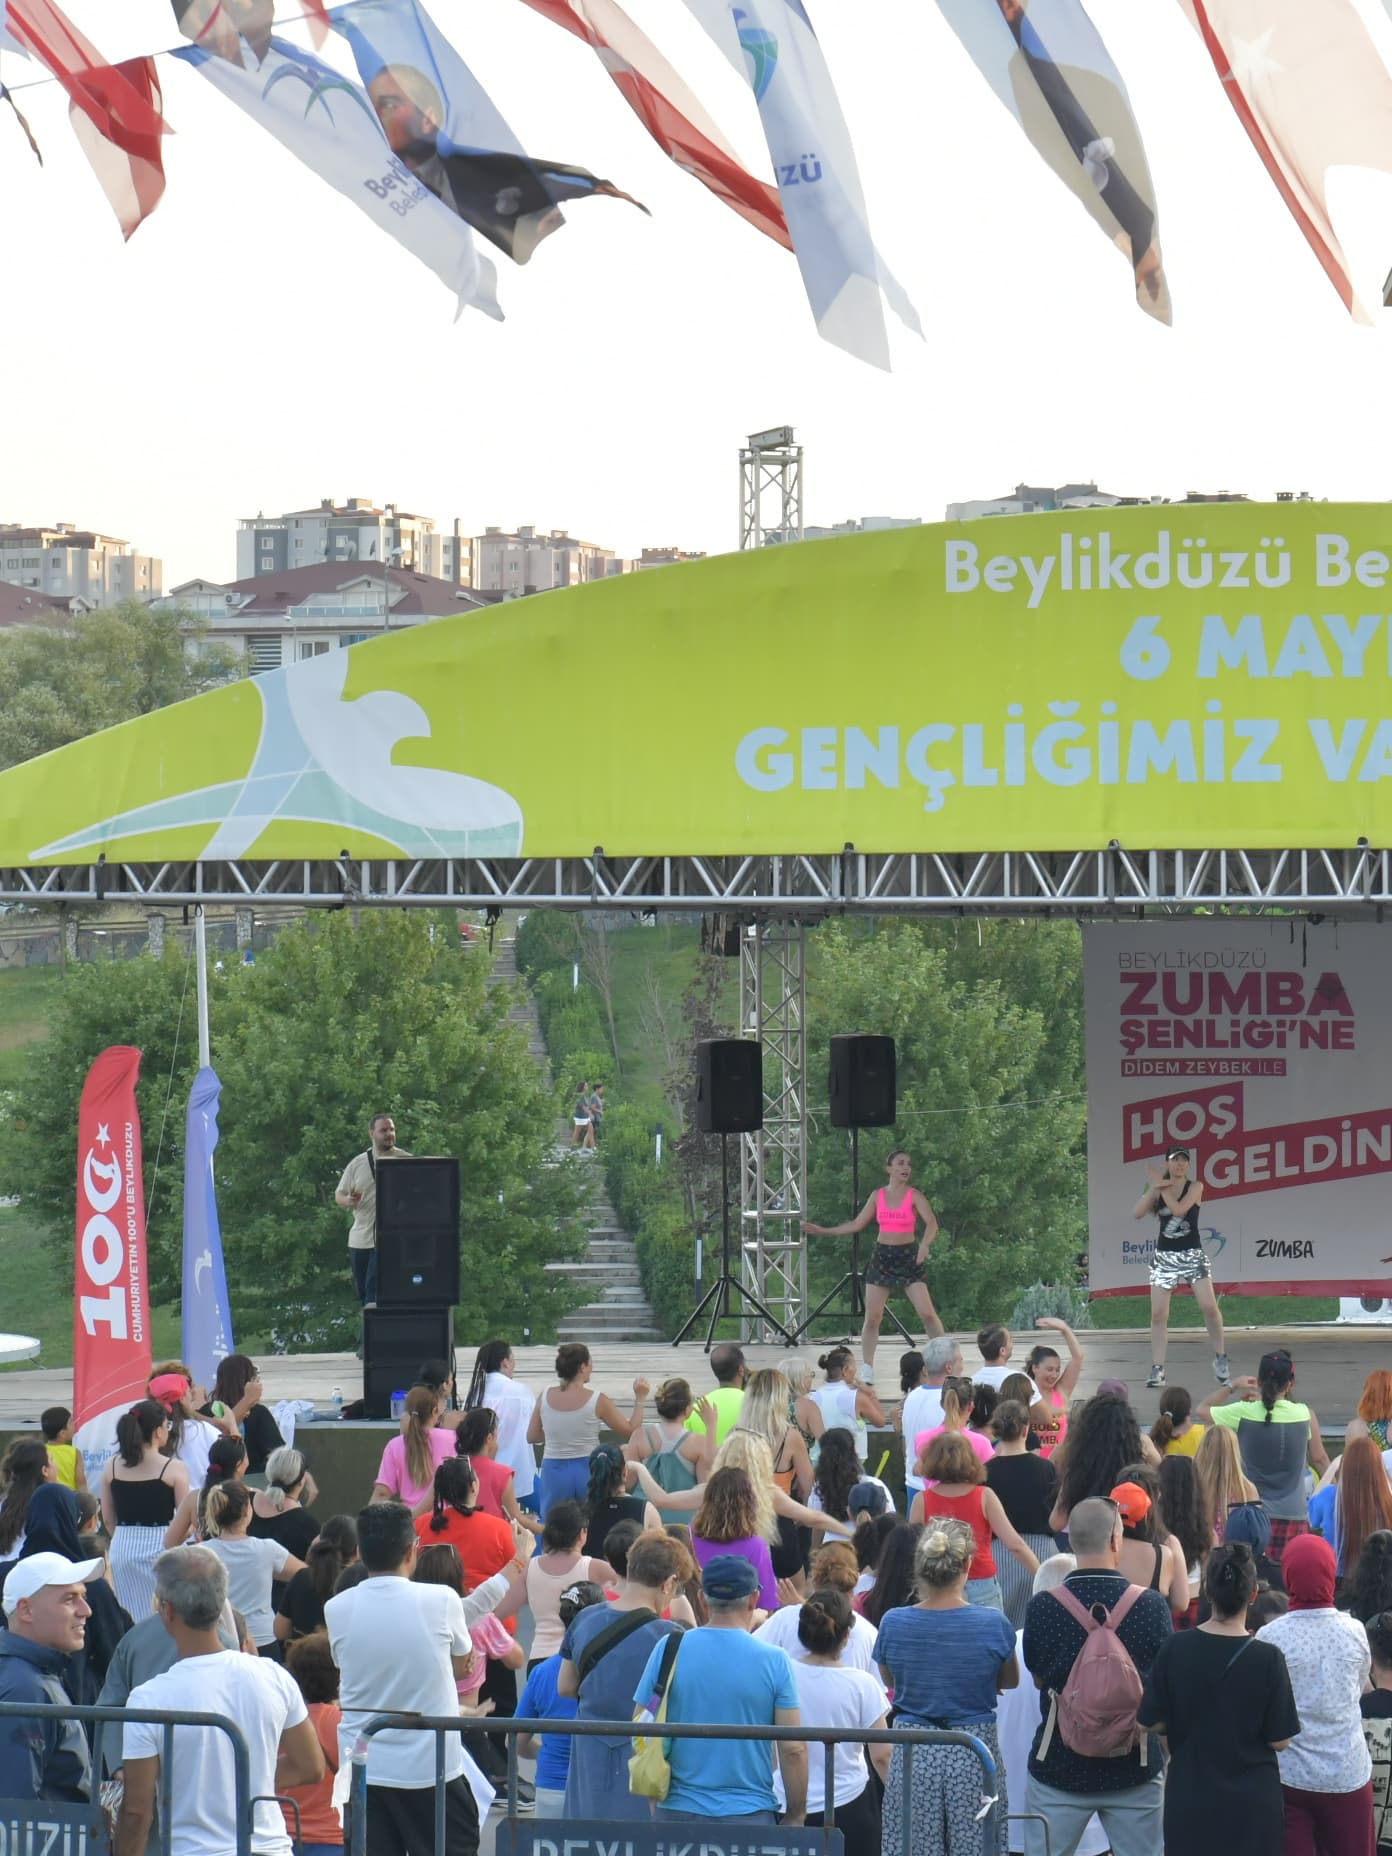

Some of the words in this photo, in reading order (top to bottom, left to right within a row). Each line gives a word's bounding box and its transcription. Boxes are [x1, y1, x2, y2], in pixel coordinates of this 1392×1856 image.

[945, 530, 1291, 608] Beylikdüzü
[1120, 615, 1170, 680] 6
[735, 700, 1282, 812] GENÇLİĞİMİZ
[1118, 947, 1267, 968] BEYLİKDÜZÜ
[1120, 971, 1354, 1016] ZUMBA
[1124, 1059, 1180, 1075] DİDEM
[1186, 1060, 1251, 1074] ZEYBEK
[1258, 1059, 1283, 1074] İLE
[1131, 1095, 1237, 1150] HOŞ
[1255, 1239, 1315, 1259] ZUMBA
